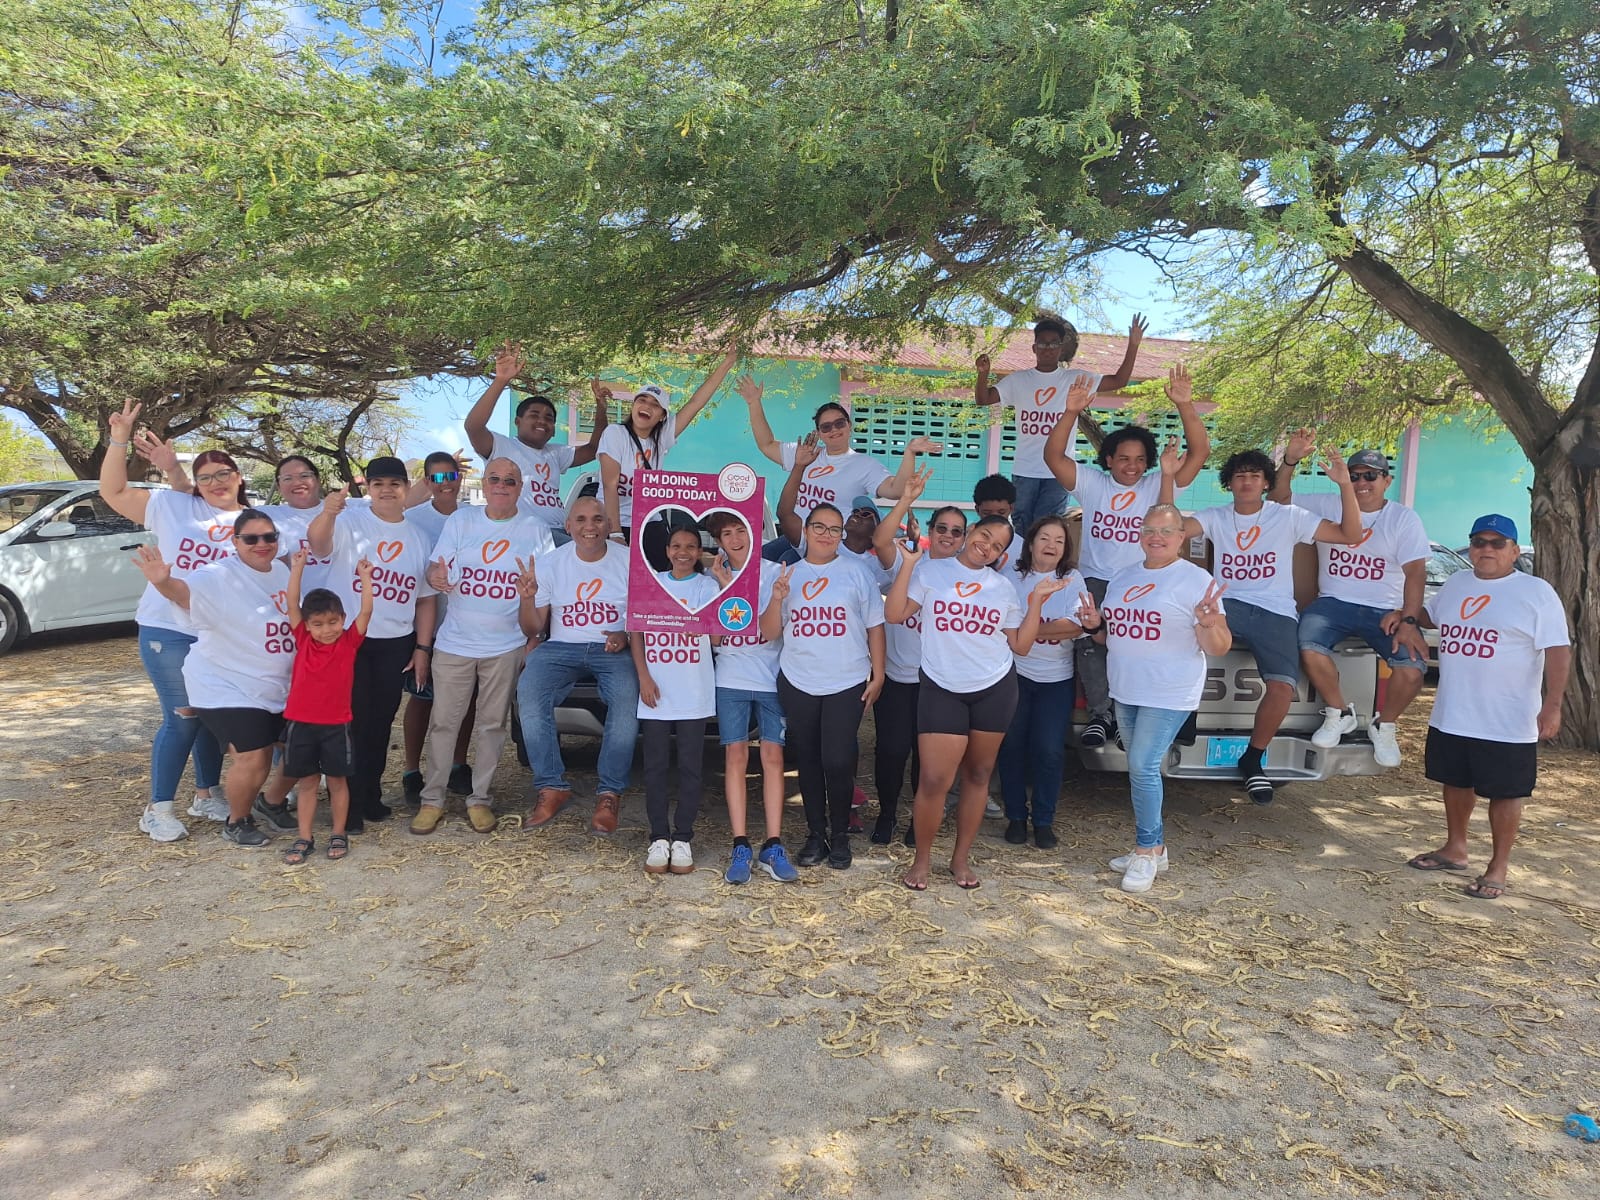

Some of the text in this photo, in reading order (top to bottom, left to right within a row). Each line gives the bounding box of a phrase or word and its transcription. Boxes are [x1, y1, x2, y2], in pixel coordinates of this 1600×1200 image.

[1021, 423, 1053, 436] GOO
[642, 473, 659, 484] I'M
[661, 475, 698, 486] DOING
[642, 487, 674, 499] GOOD
[676, 489, 717, 501] TODAY!
[799, 482, 836, 502] OING
[534, 494, 565, 509] GOO
[1093, 511, 1143, 529] DOING
[1091, 525, 1140, 543] GOOD
[1221, 552, 1276, 567] DOING
[1330, 548, 1386, 570] DOING
[355, 566, 417, 590] OING
[1221, 566, 1276, 580] GOOD
[1329, 562, 1384, 580] GOOD
[460, 581, 517, 600] GOOD
[562, 610, 619, 627] GOOD
[791, 606, 847, 623] DOING
[933, 600, 1001, 624] DOING
[1103, 607, 1162, 625] DOING
[792, 623, 847, 637] GOOD
[935, 617, 996, 636] GOOD
[1109, 622, 1161, 640] GOOD
[1440, 624, 1499, 643] DOING
[265, 639, 298, 653] GO
[1440, 639, 1495, 658] GOOD
[646, 649, 700, 663] GOOD
